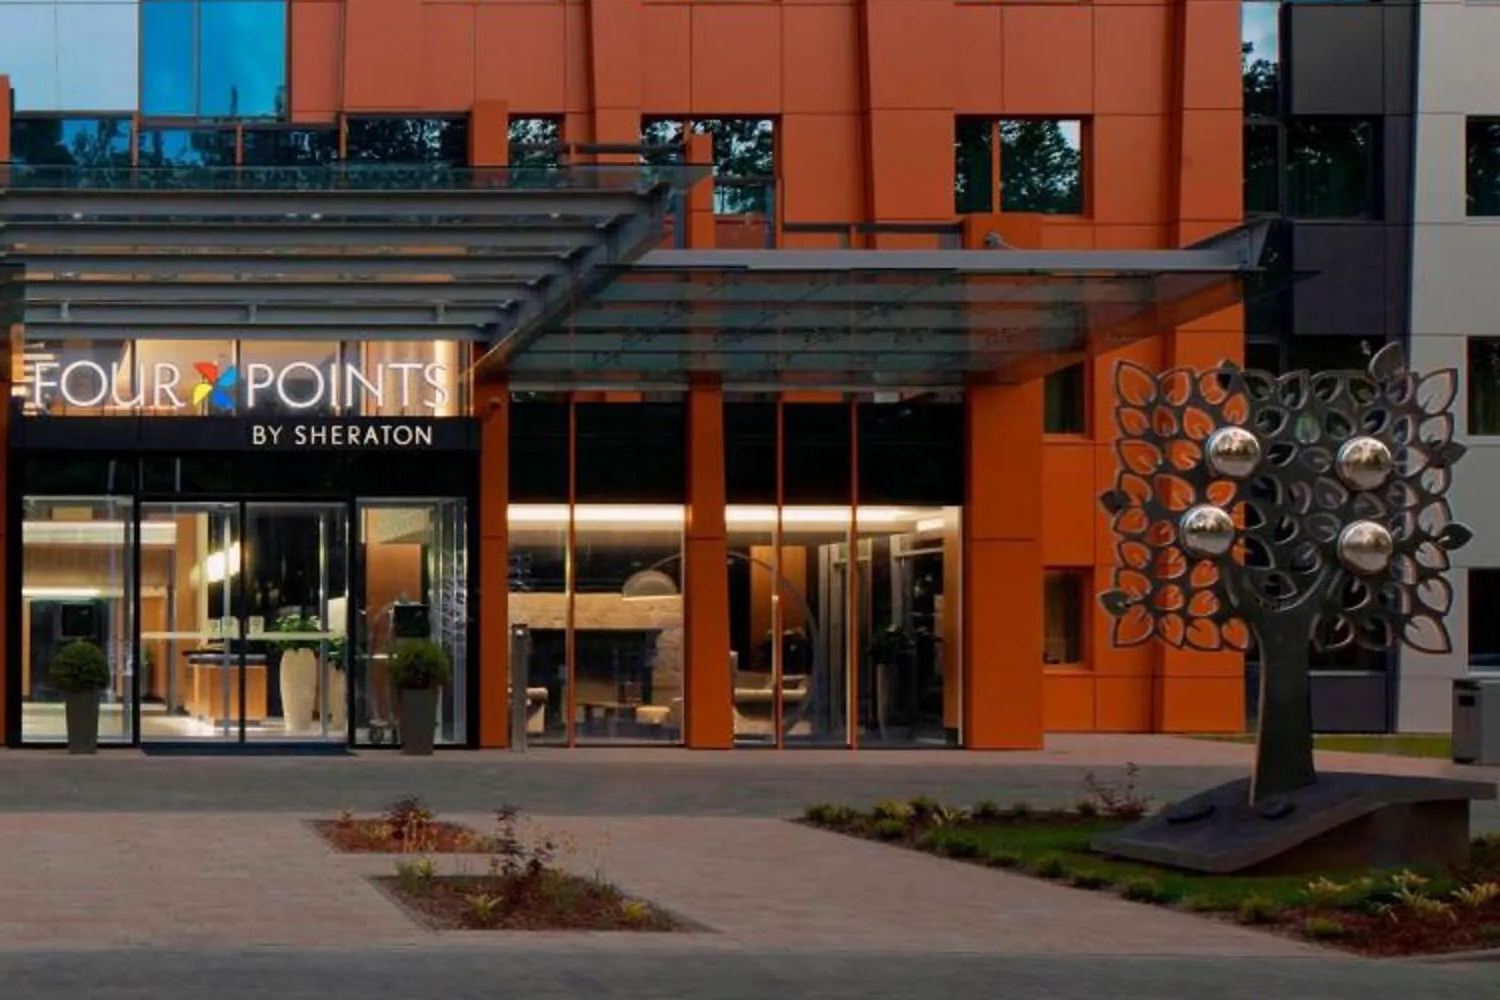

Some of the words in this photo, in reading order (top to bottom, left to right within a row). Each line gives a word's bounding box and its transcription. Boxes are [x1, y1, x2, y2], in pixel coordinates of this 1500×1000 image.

[35, 360, 187, 408] FOUR
[247, 361, 448, 408] POINTS
[252, 425, 283, 445] BY
[294, 425, 432, 445] SHERATON
